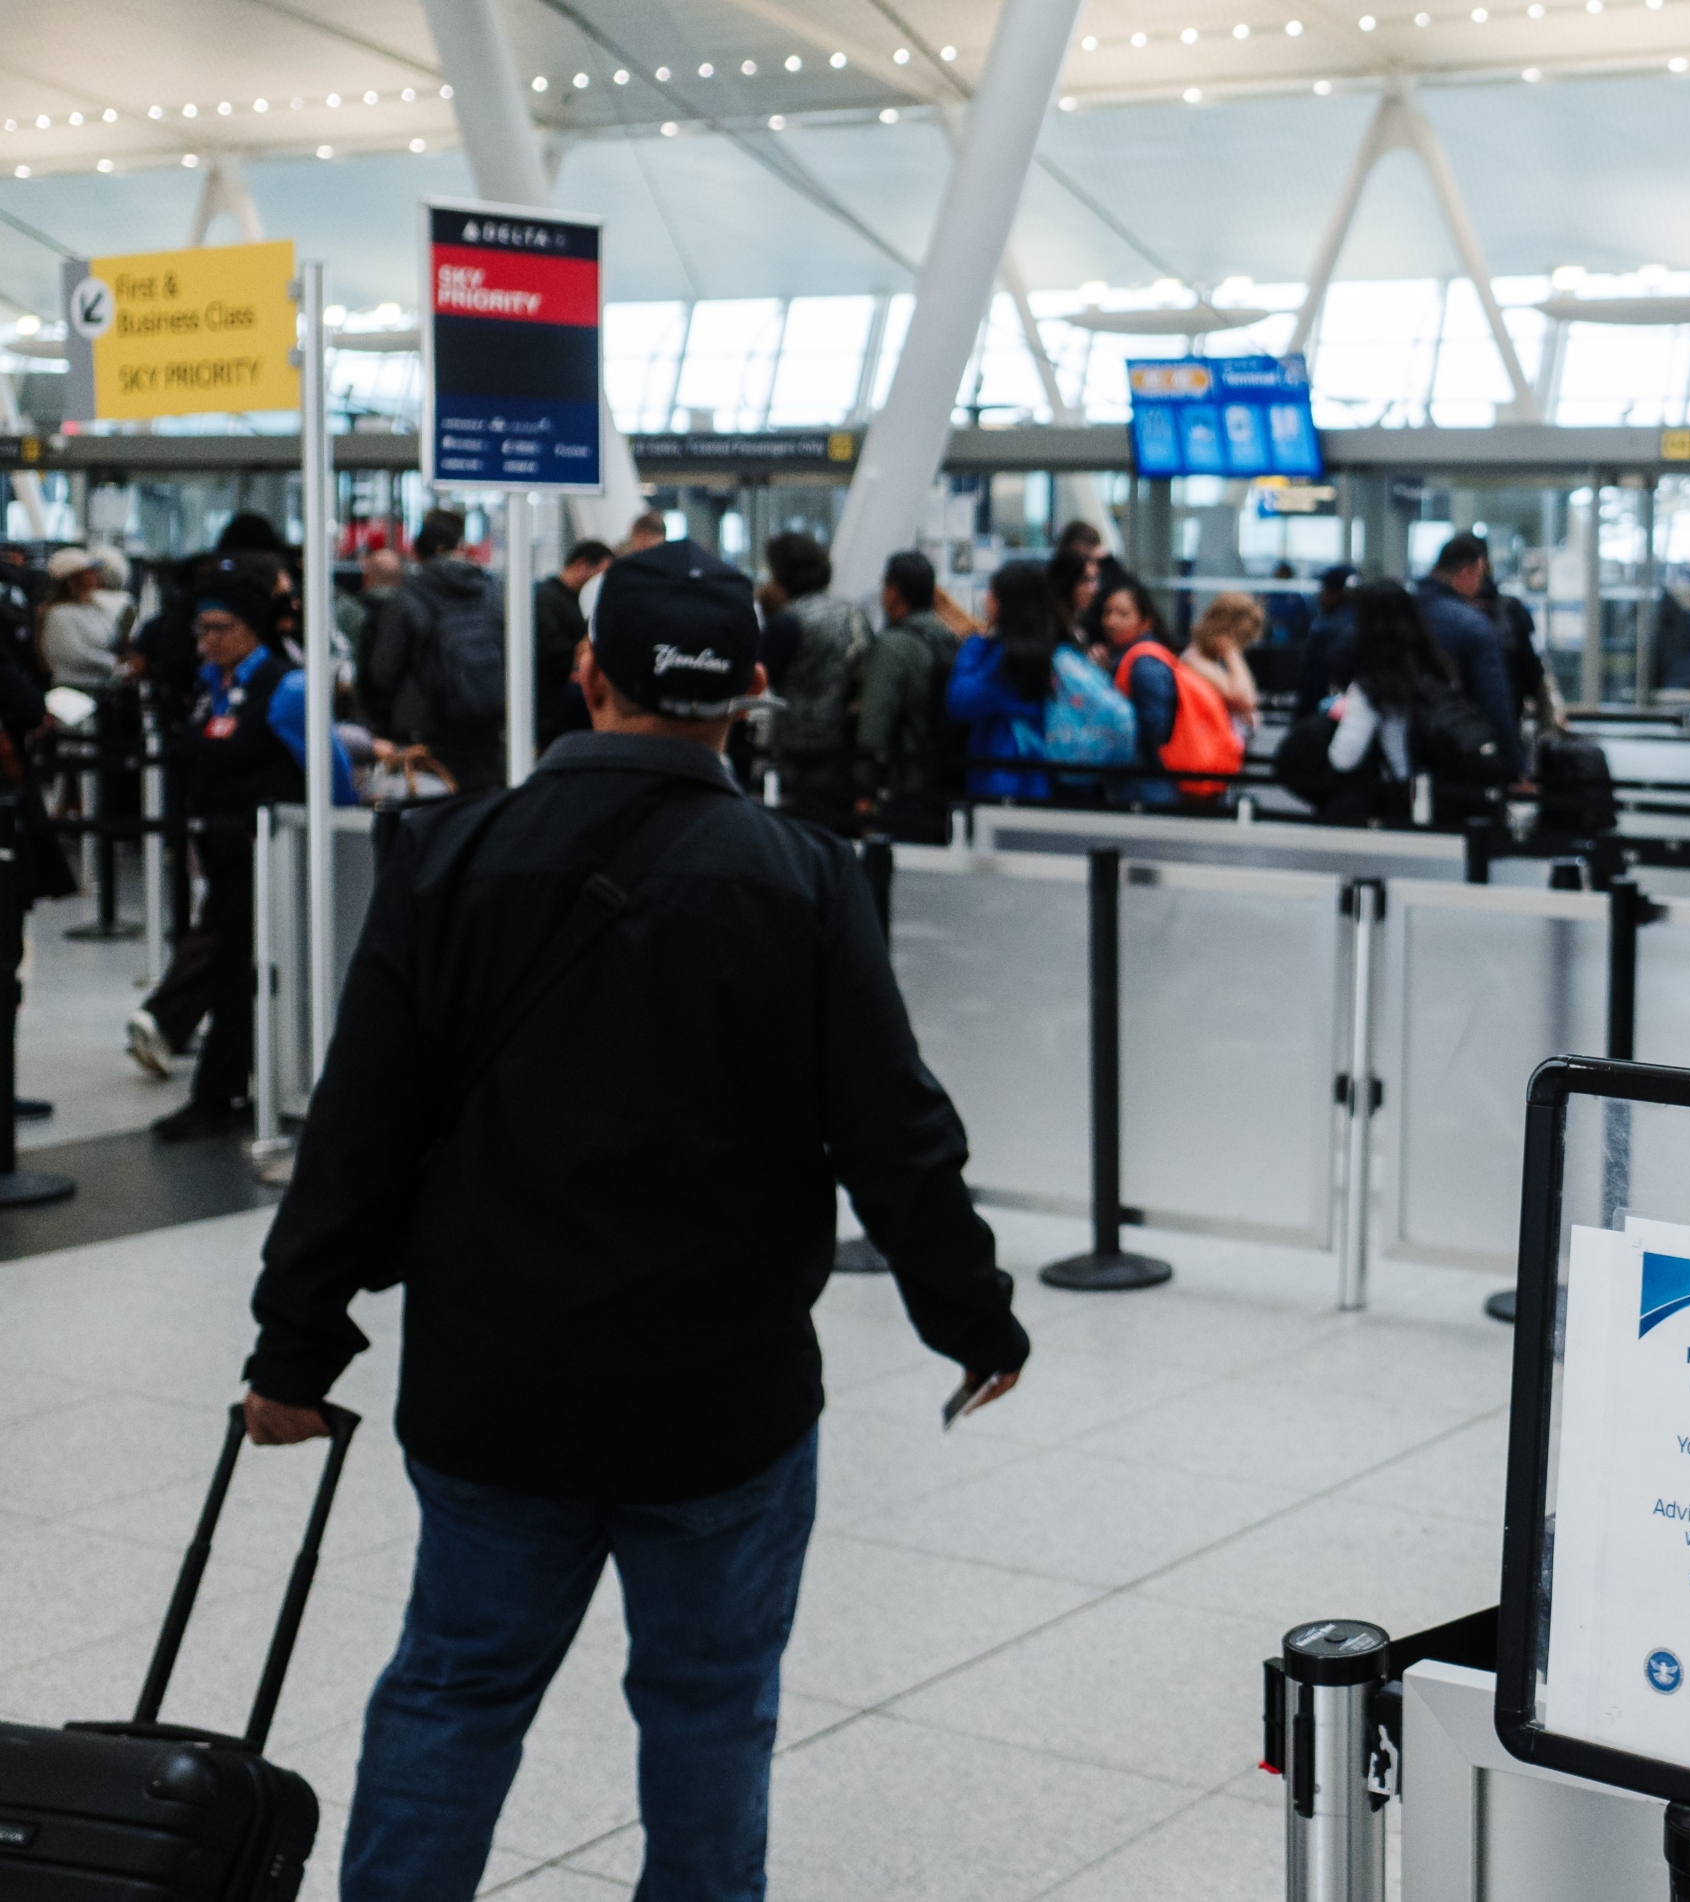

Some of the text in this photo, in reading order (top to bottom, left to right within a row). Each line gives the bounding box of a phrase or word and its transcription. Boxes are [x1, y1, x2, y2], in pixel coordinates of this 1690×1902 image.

[482, 220, 550, 248] DELTA
[115, 273, 156, 299] First
[438, 264, 485, 288] SKY
[438, 286, 542, 315] PRIORITY
[116, 301, 256, 338] Business Class
[118, 356, 260, 394] SKY PRIORITY
